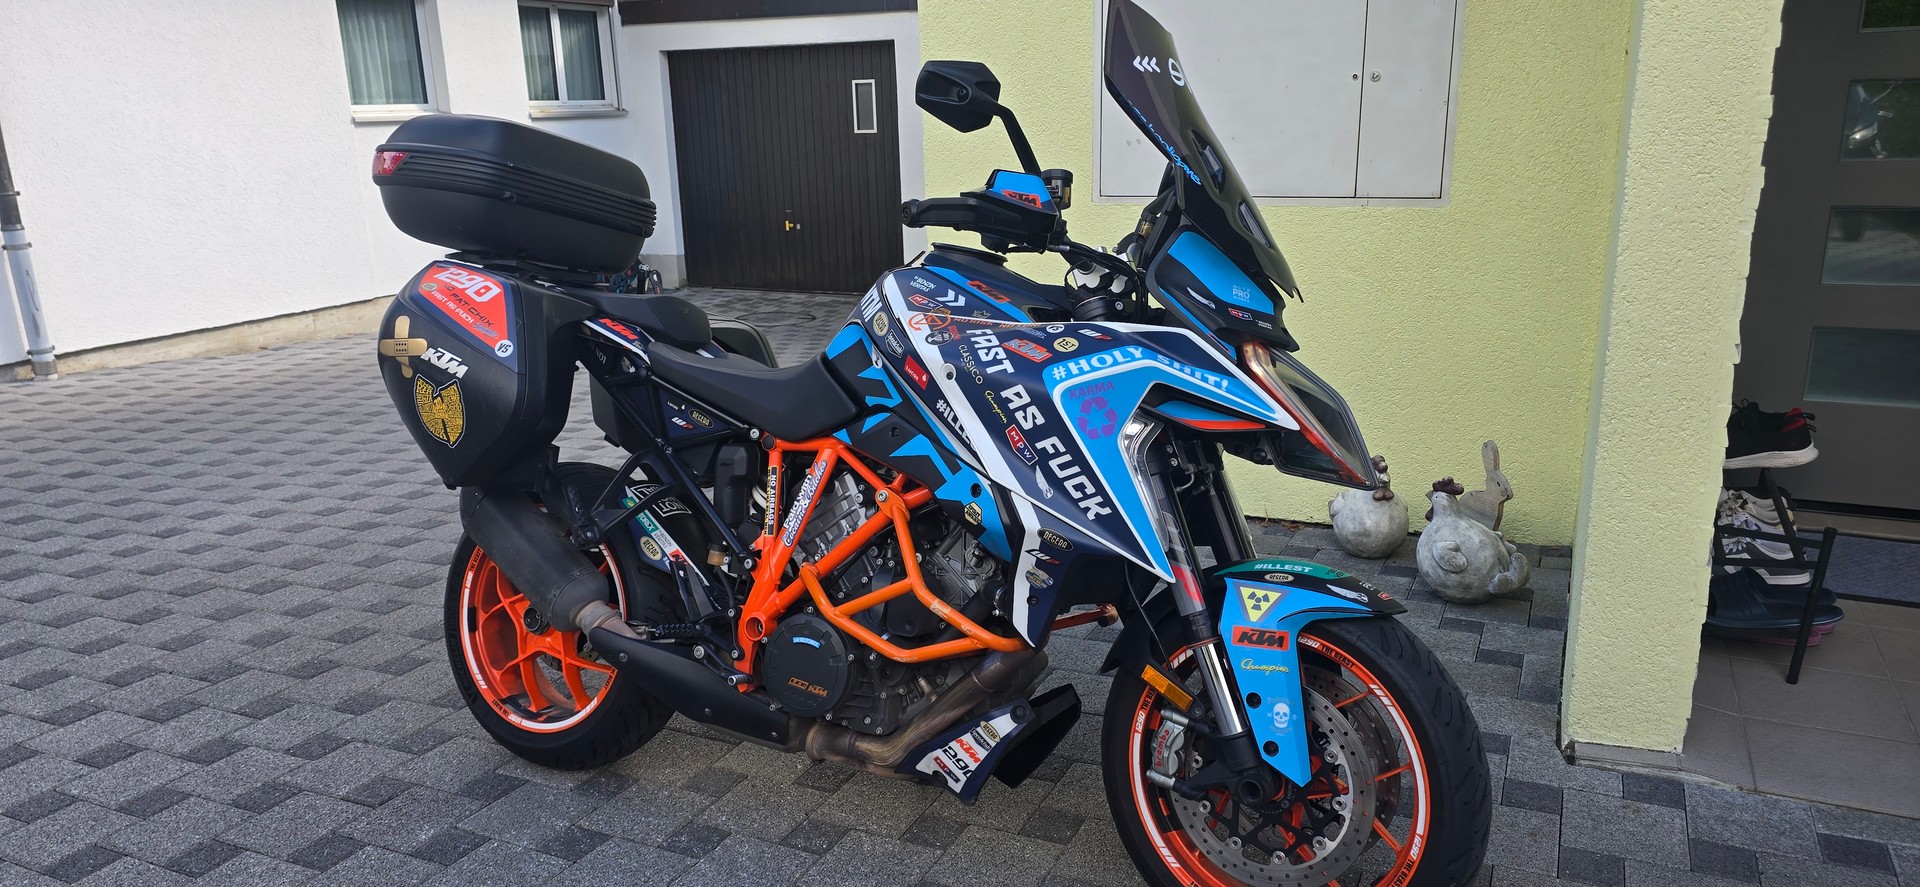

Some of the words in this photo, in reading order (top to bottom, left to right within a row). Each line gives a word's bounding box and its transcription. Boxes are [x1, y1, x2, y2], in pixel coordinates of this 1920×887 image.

[1007, 192, 1037, 206] KTM
[433, 268, 502, 303] 1290
[1232, 288, 1250, 299] PRO
[450, 293, 470, 307] FAT
[468, 307, 494, 327] CHIX
[598, 317, 639, 341] KTM
[497, 342, 511, 353] VS
[1003, 339, 1049, 360] KTM
[1058, 338, 1077, 350] 1ST
[420, 347, 469, 379] KTM
[958, 344, 984, 385] CLASSICO
[1051, 347, 1144, 381] #HOLY
[1156, 354, 1229, 392] SHIT!
[1069, 380, 1115, 400] KARMA
[985, 389, 1008, 425] Champion
[966, 328, 1015, 375] FAST
[1000, 383, 1046, 431] AS
[1034, 435, 1112, 521] FUCK
[770, 474, 777, 487] NO
[783, 500, 800, 529] Paid
[797, 474, 813, 501] with
[1254, 562, 1313, 573] #ILLEST
[1237, 628, 1286, 648] KTM
[1298, 636, 1320, 648] 1290
[1333, 652, 1355, 669] BEAST
[1241, 658, 1290, 676] Champion
[808, 684, 828, 697] KTM
[954, 737, 982, 764] KTM
[1155, 729, 1171, 768] brembo
